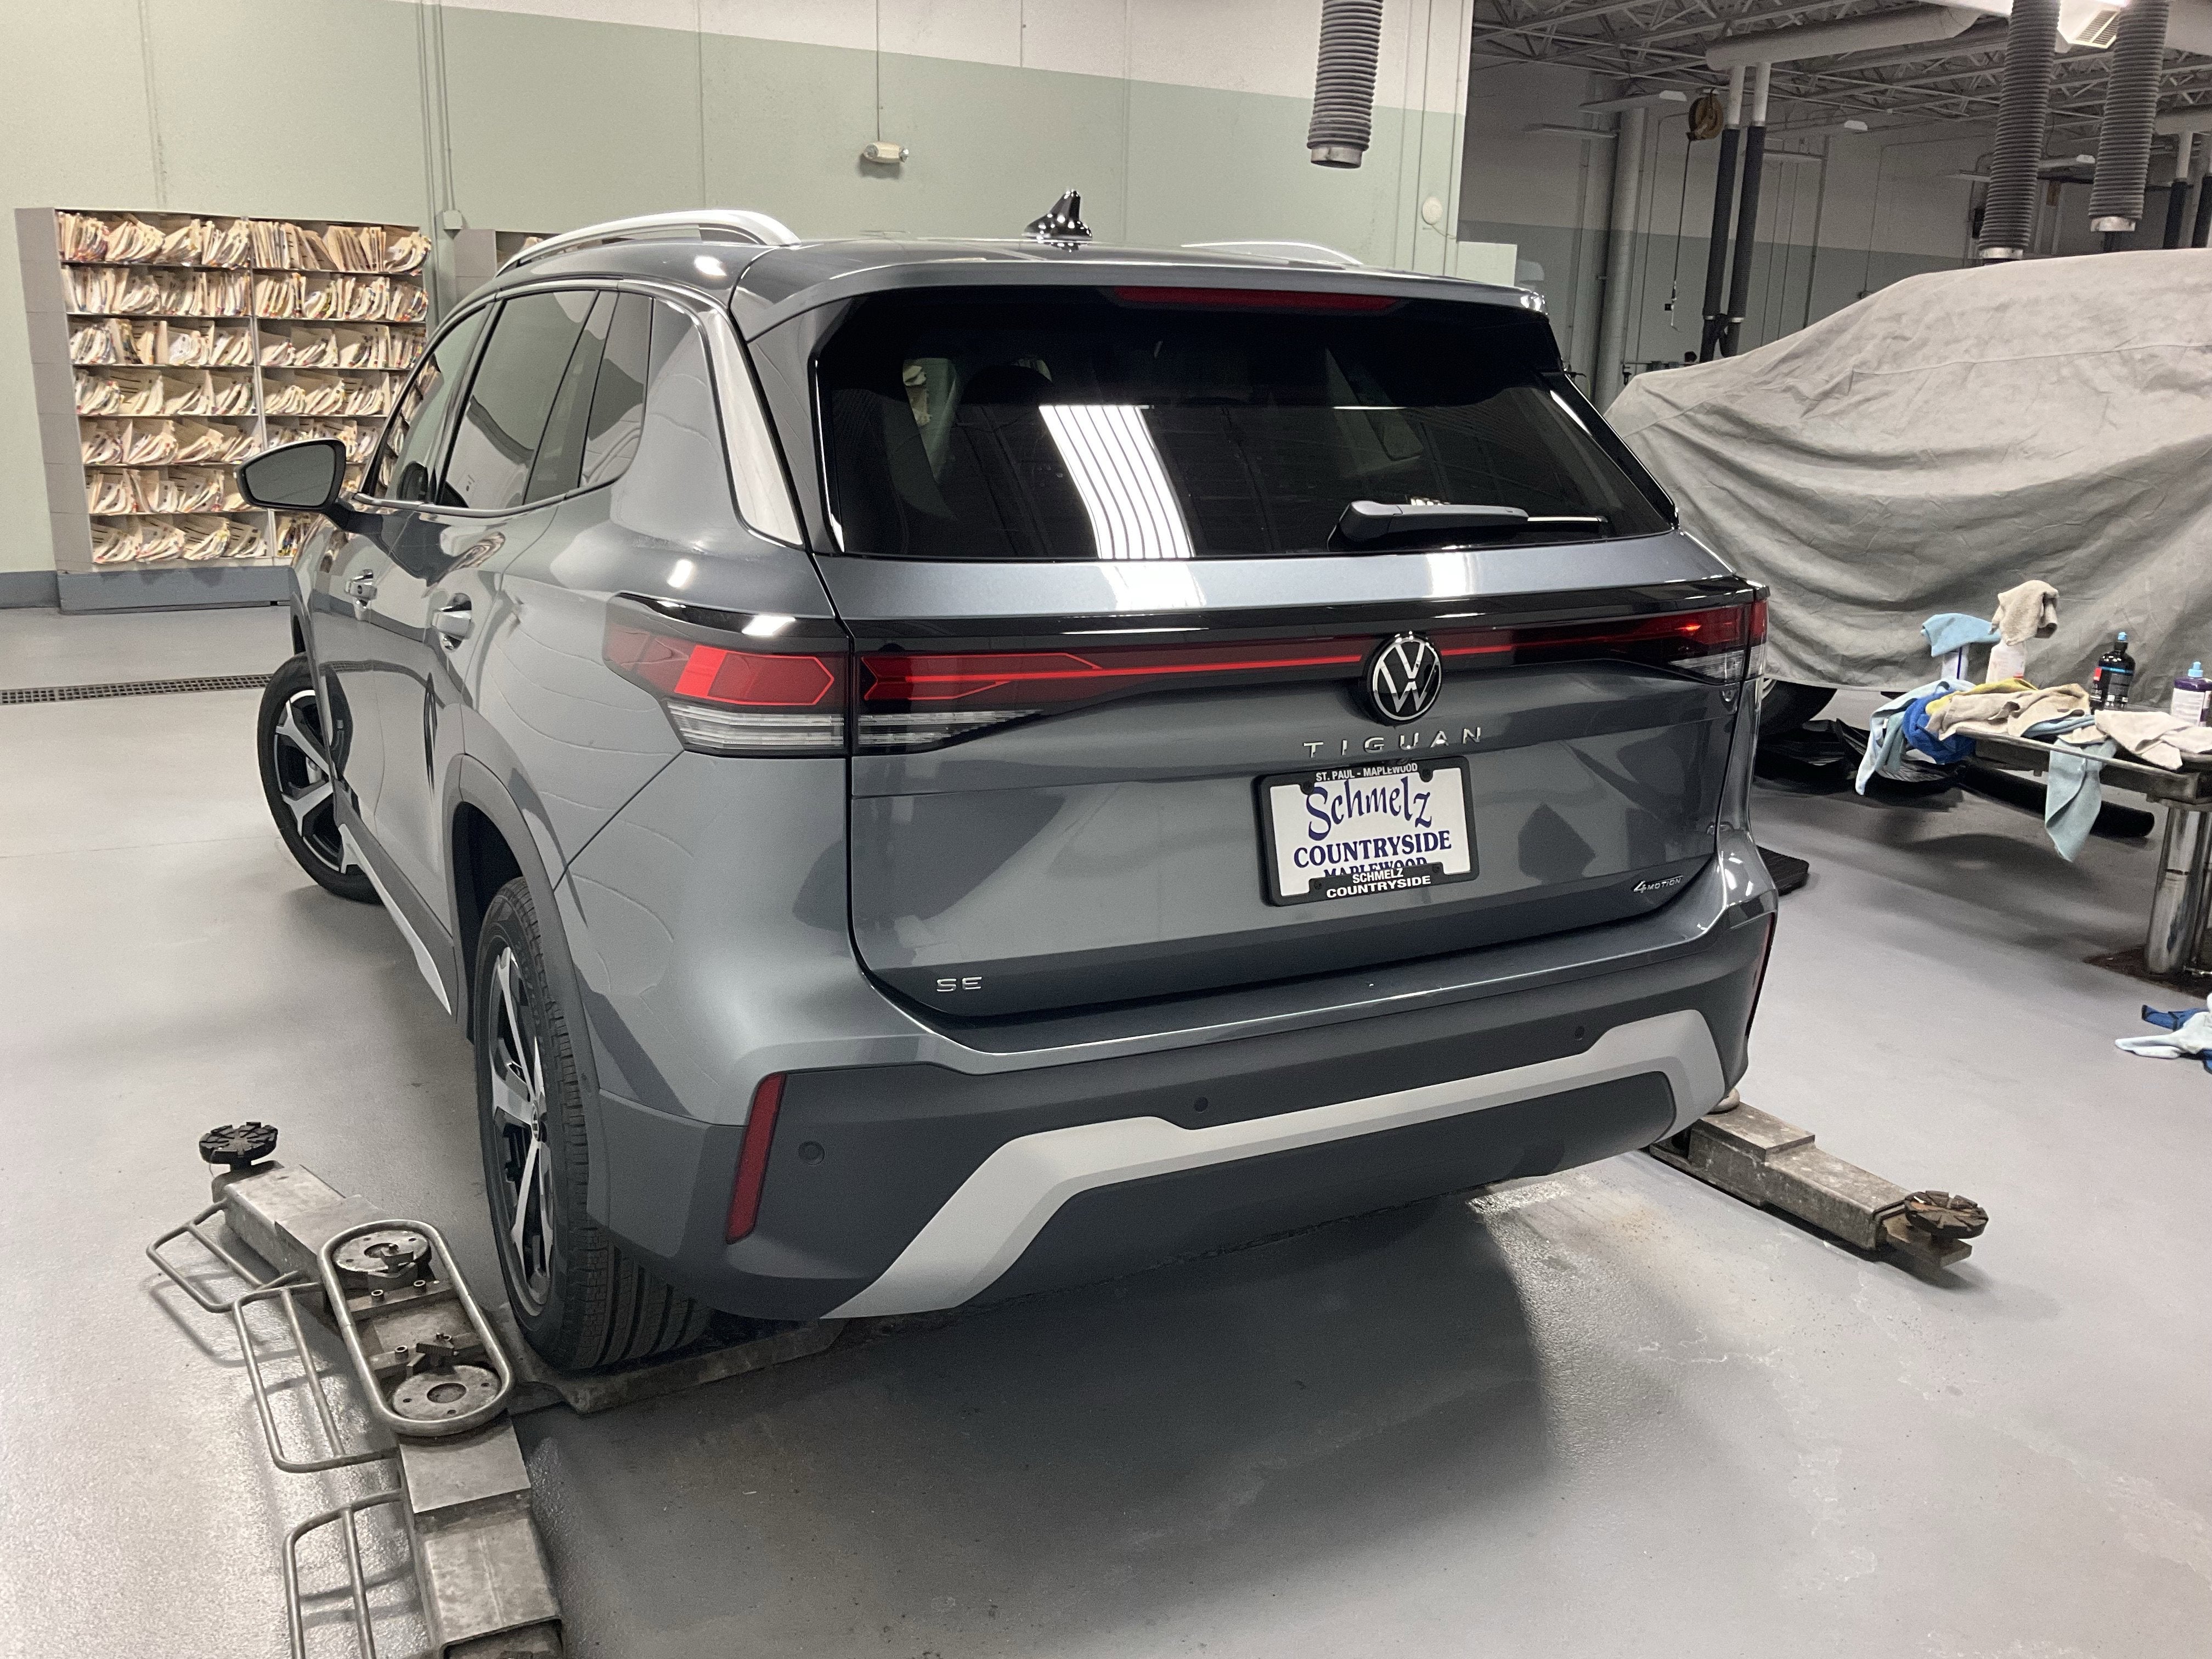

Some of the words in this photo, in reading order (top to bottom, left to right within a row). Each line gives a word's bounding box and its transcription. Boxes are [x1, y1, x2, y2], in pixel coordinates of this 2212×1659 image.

[1304, 727, 1481, 758] TIGUAN
[1316, 771, 1330, 782] ST.
[1332, 769, 1355, 780] PAUL
[1363, 763, 1418, 777] MAPLEWOOD
[1306, 776, 1432, 841] Schmelz
[1294, 830, 1452, 868] COUNTRYSIDE
[1352, 868, 1404, 884] SCHMELZ
[1633, 876, 1682, 893] 4MOTION
[1326, 876, 1431, 898] COUNTRYSIDE
[936, 977, 982, 992] SE
